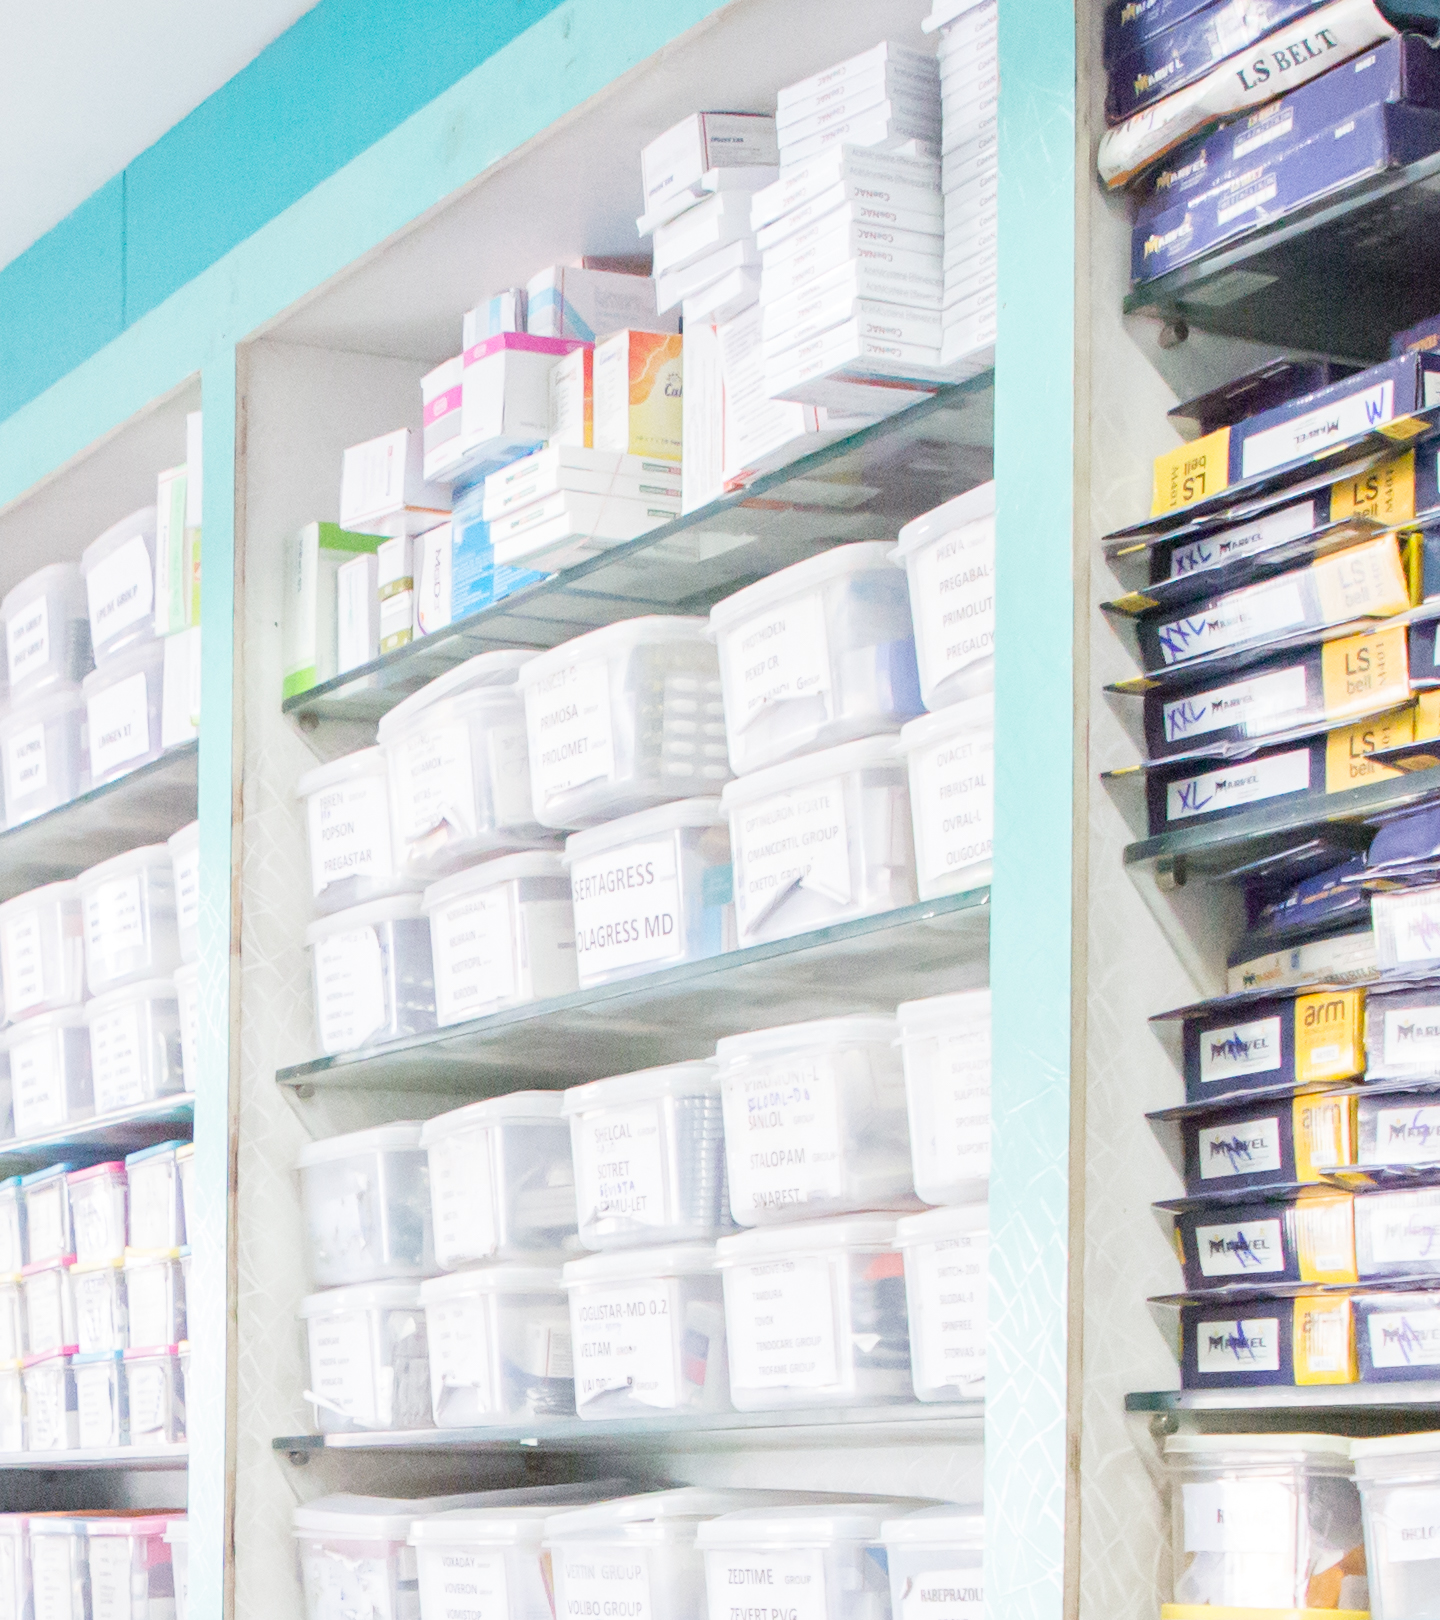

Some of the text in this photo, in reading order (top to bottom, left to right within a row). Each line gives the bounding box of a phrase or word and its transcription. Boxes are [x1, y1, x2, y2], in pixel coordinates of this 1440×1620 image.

[1236, 29, 1338, 92] LS BELT
[769, 655, 779, 670] CR
[540, 704, 579, 729] PRIMOSA
[542, 737, 589, 766] PROLOMET
[935, 742, 973, 767] OVACET
[1215, 771, 1259, 795] MARVEL
[1177, 782, 1212, 812] XL
[744, 796, 831, 833] OPTINEURON FORTE
[942, 811, 982, 834] OVRAL-L
[324, 850, 373, 872] PREGASTAR
[572, 860, 656, 903] SERTAGRESS
[643, 912, 675, 941] MD
[594, 1123, 633, 1143] SHELCAL
[597, 1160, 630, 1179] SOTRET
[750, 1149, 806, 1170] STALOPAM
[752, 1188, 801, 1210] SINAREST
[649, 1299, 668, 1316] 0.2
[580, 1341, 611, 1358] VELTAM
[727, 1568, 812, 1585] ZEDTIME GROUP
[603, 1601, 643, 1617] GROUP
